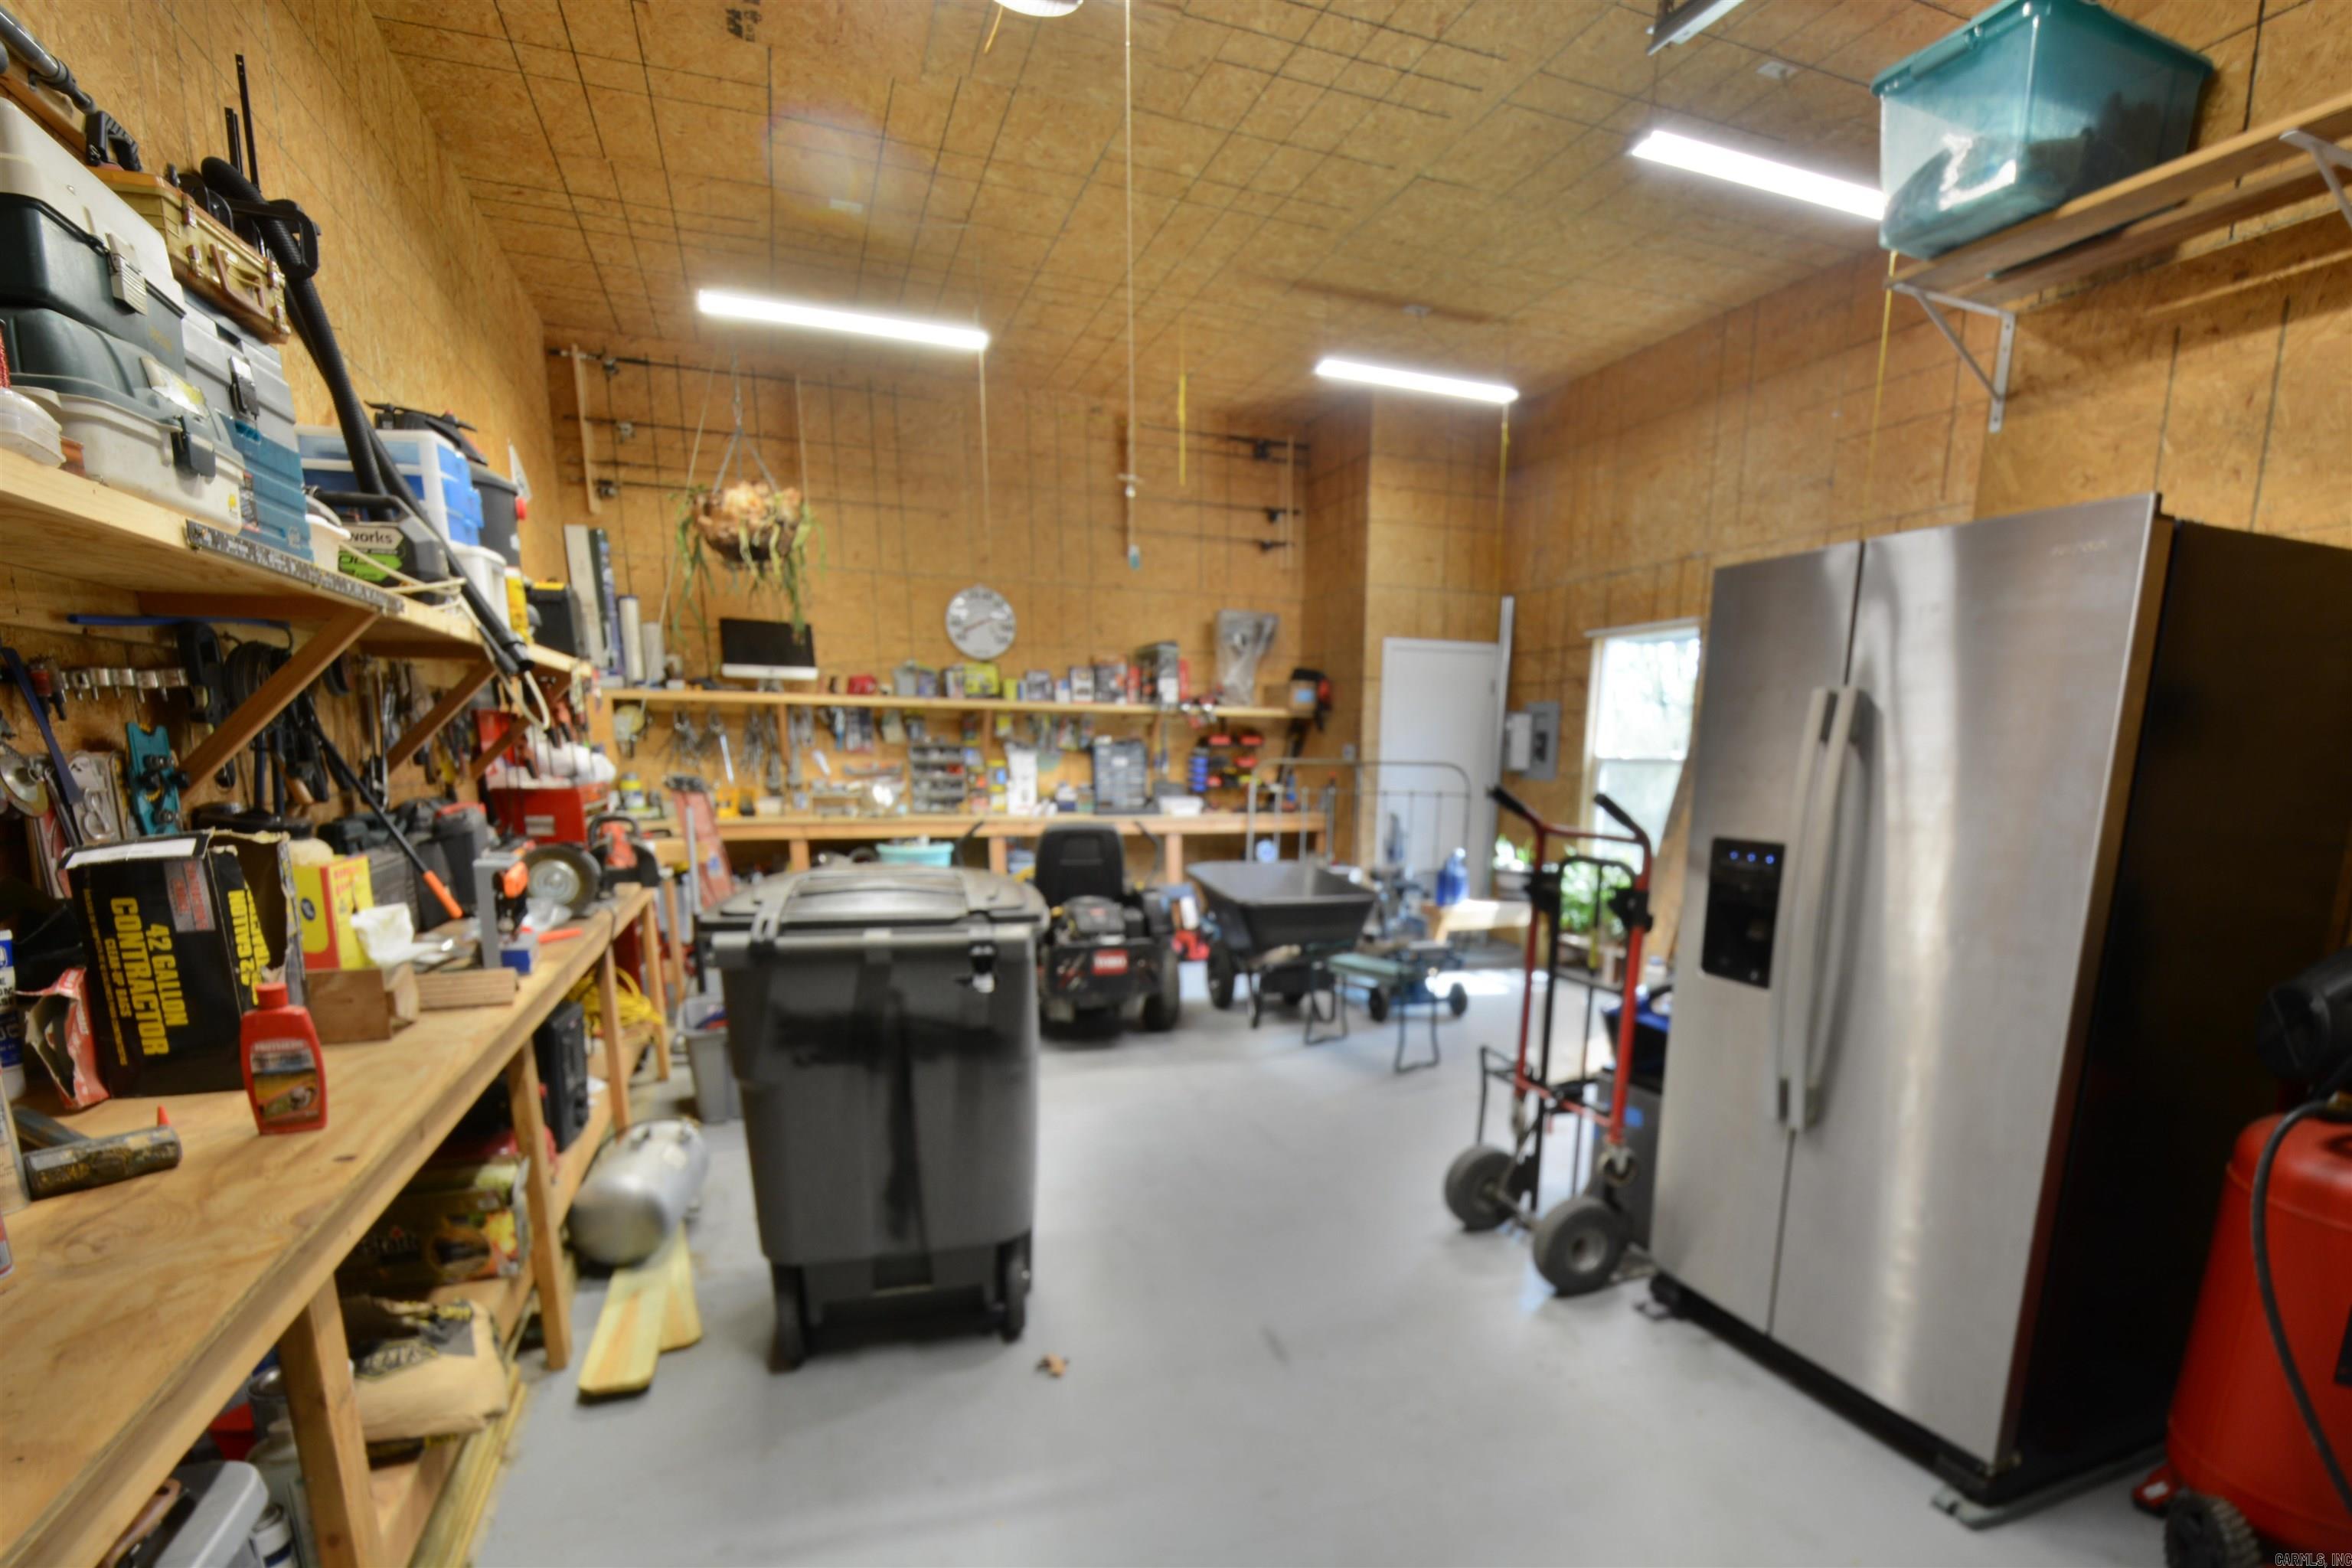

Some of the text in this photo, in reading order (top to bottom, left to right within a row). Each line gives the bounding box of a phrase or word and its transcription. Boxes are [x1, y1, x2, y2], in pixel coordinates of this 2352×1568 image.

[110, 897, 170, 1056] CONTRACTOR
[145, 923, 189, 1026] 42 GALLON
